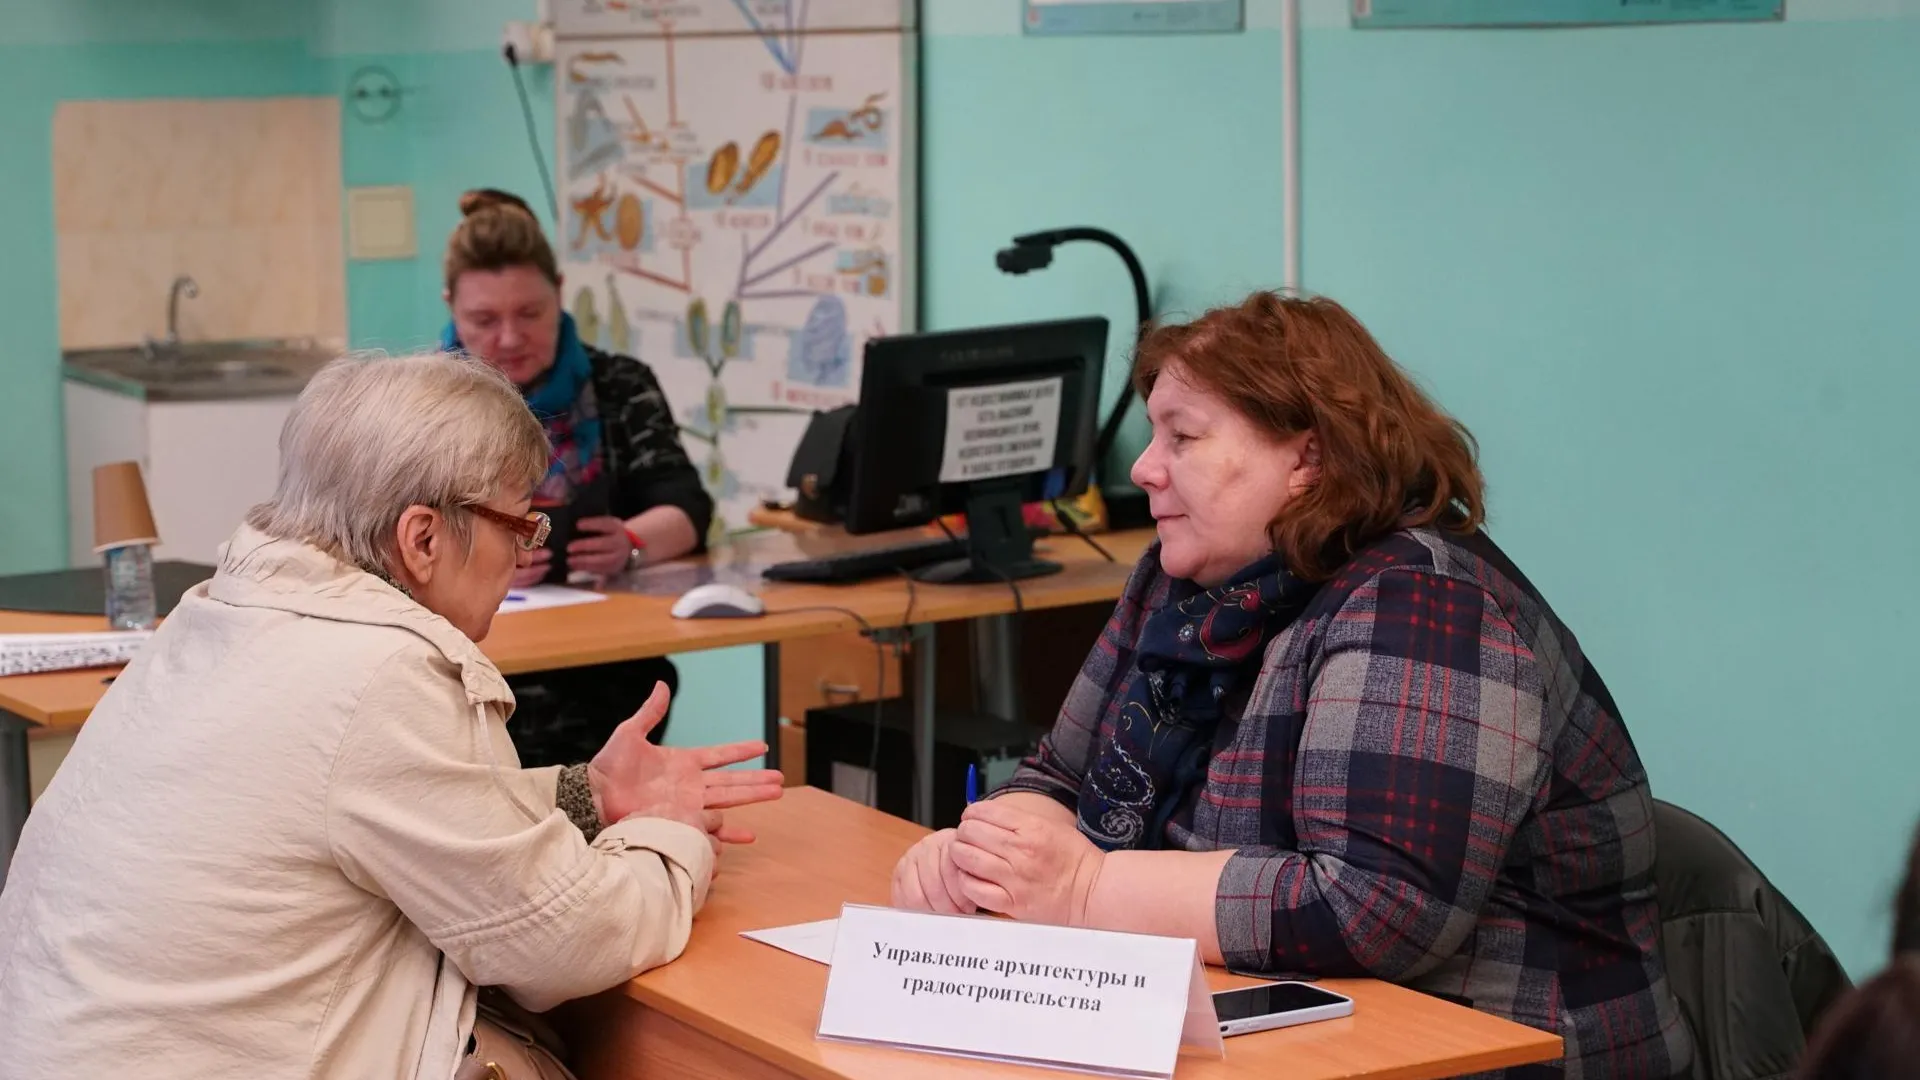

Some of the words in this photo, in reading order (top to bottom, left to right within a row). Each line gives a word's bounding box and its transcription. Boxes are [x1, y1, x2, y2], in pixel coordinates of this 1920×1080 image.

[872, 941, 989, 971] Управление
[994, 957, 1127, 988] архитектуры
[1133, 974, 1147, 988] и
[902, 977, 1102, 1012] градостроительства
